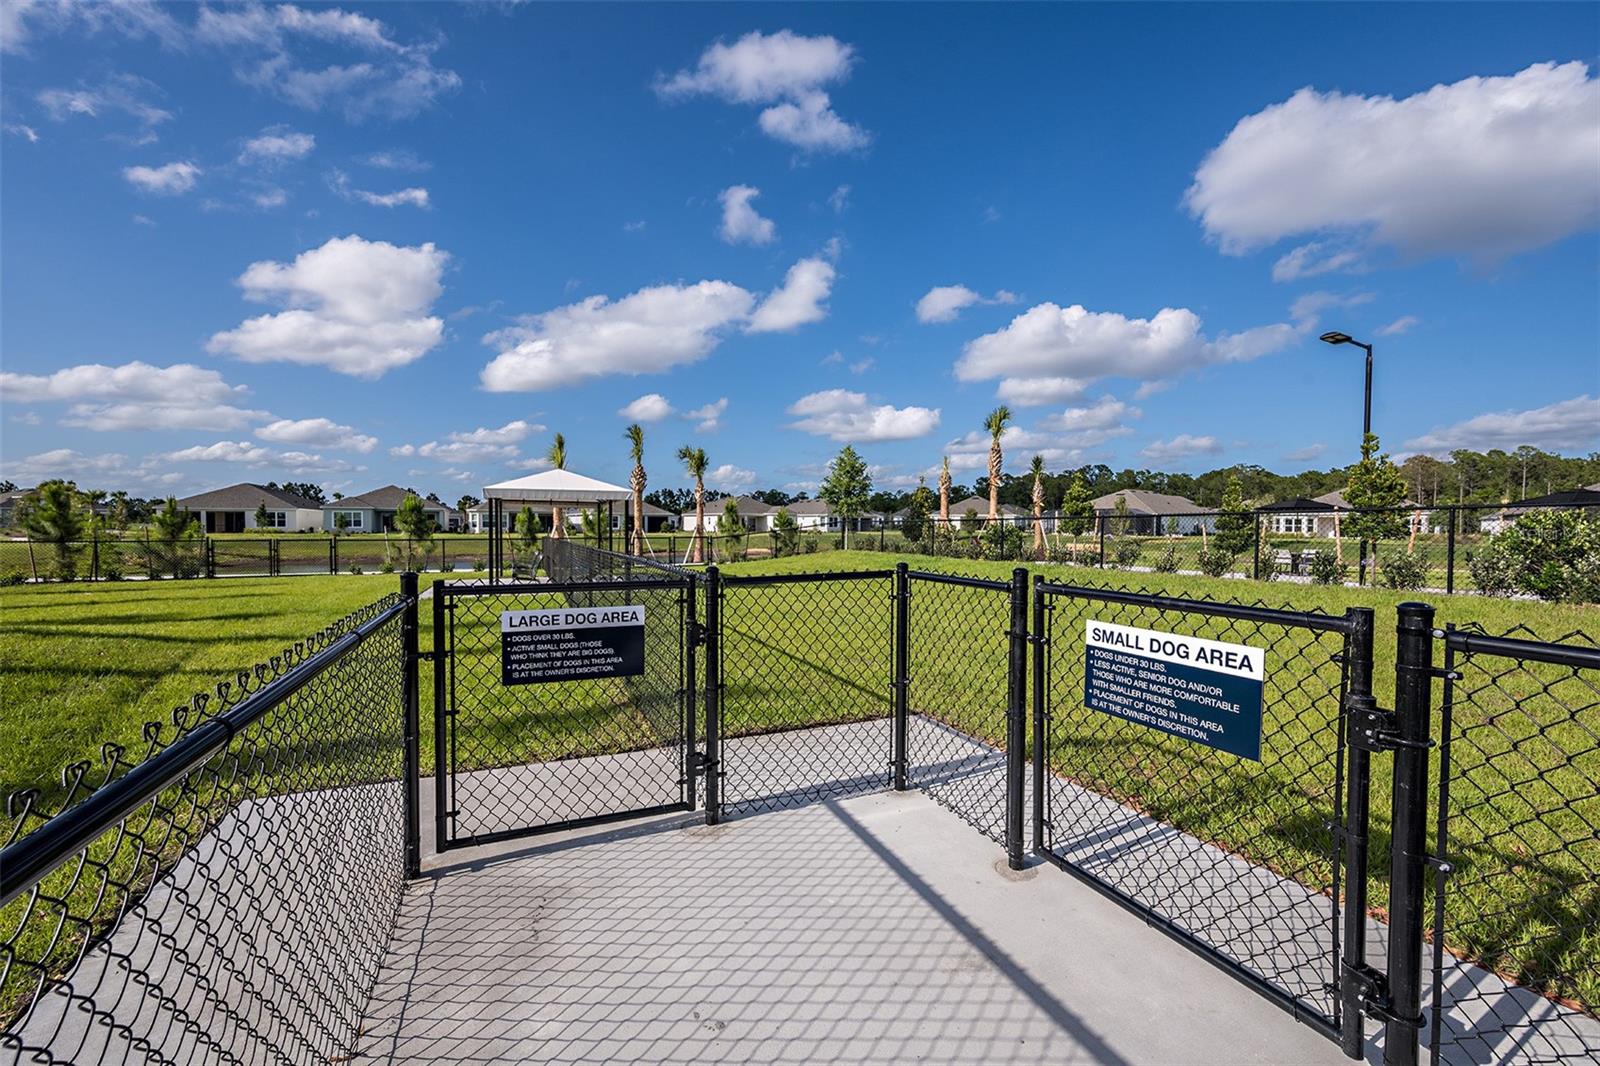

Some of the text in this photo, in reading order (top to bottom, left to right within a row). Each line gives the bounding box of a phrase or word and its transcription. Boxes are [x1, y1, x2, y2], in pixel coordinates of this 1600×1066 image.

[509, 611, 639, 628] LARGE DOG AREA
[512, 661, 551, 670] PLACEMENT
[1092, 628, 1253, 672] SMALL DOG AREA
[1095, 650, 1113, 660] DOGS
[1114, 654, 1139, 665] UNDER
[1149, 662, 1167, 672] LBS.
[1092, 679, 1177, 708] WITH SMALLER FRIENDS.
[1093, 669, 1240, 713] THOSE WHO ARE MORE COMFORTABLE
[1094, 660, 1222, 696] LESS ACTIVE, SENIOR DOG AND/OR
[1094, 689, 1223, 733] PLACEMENT OF DOGS IN THIS AREA
[1108, 703, 1122, 714] THE
[1123, 707, 1156, 724] OWNER'S
[1158, 718, 1209, 740] DISCRETION.
